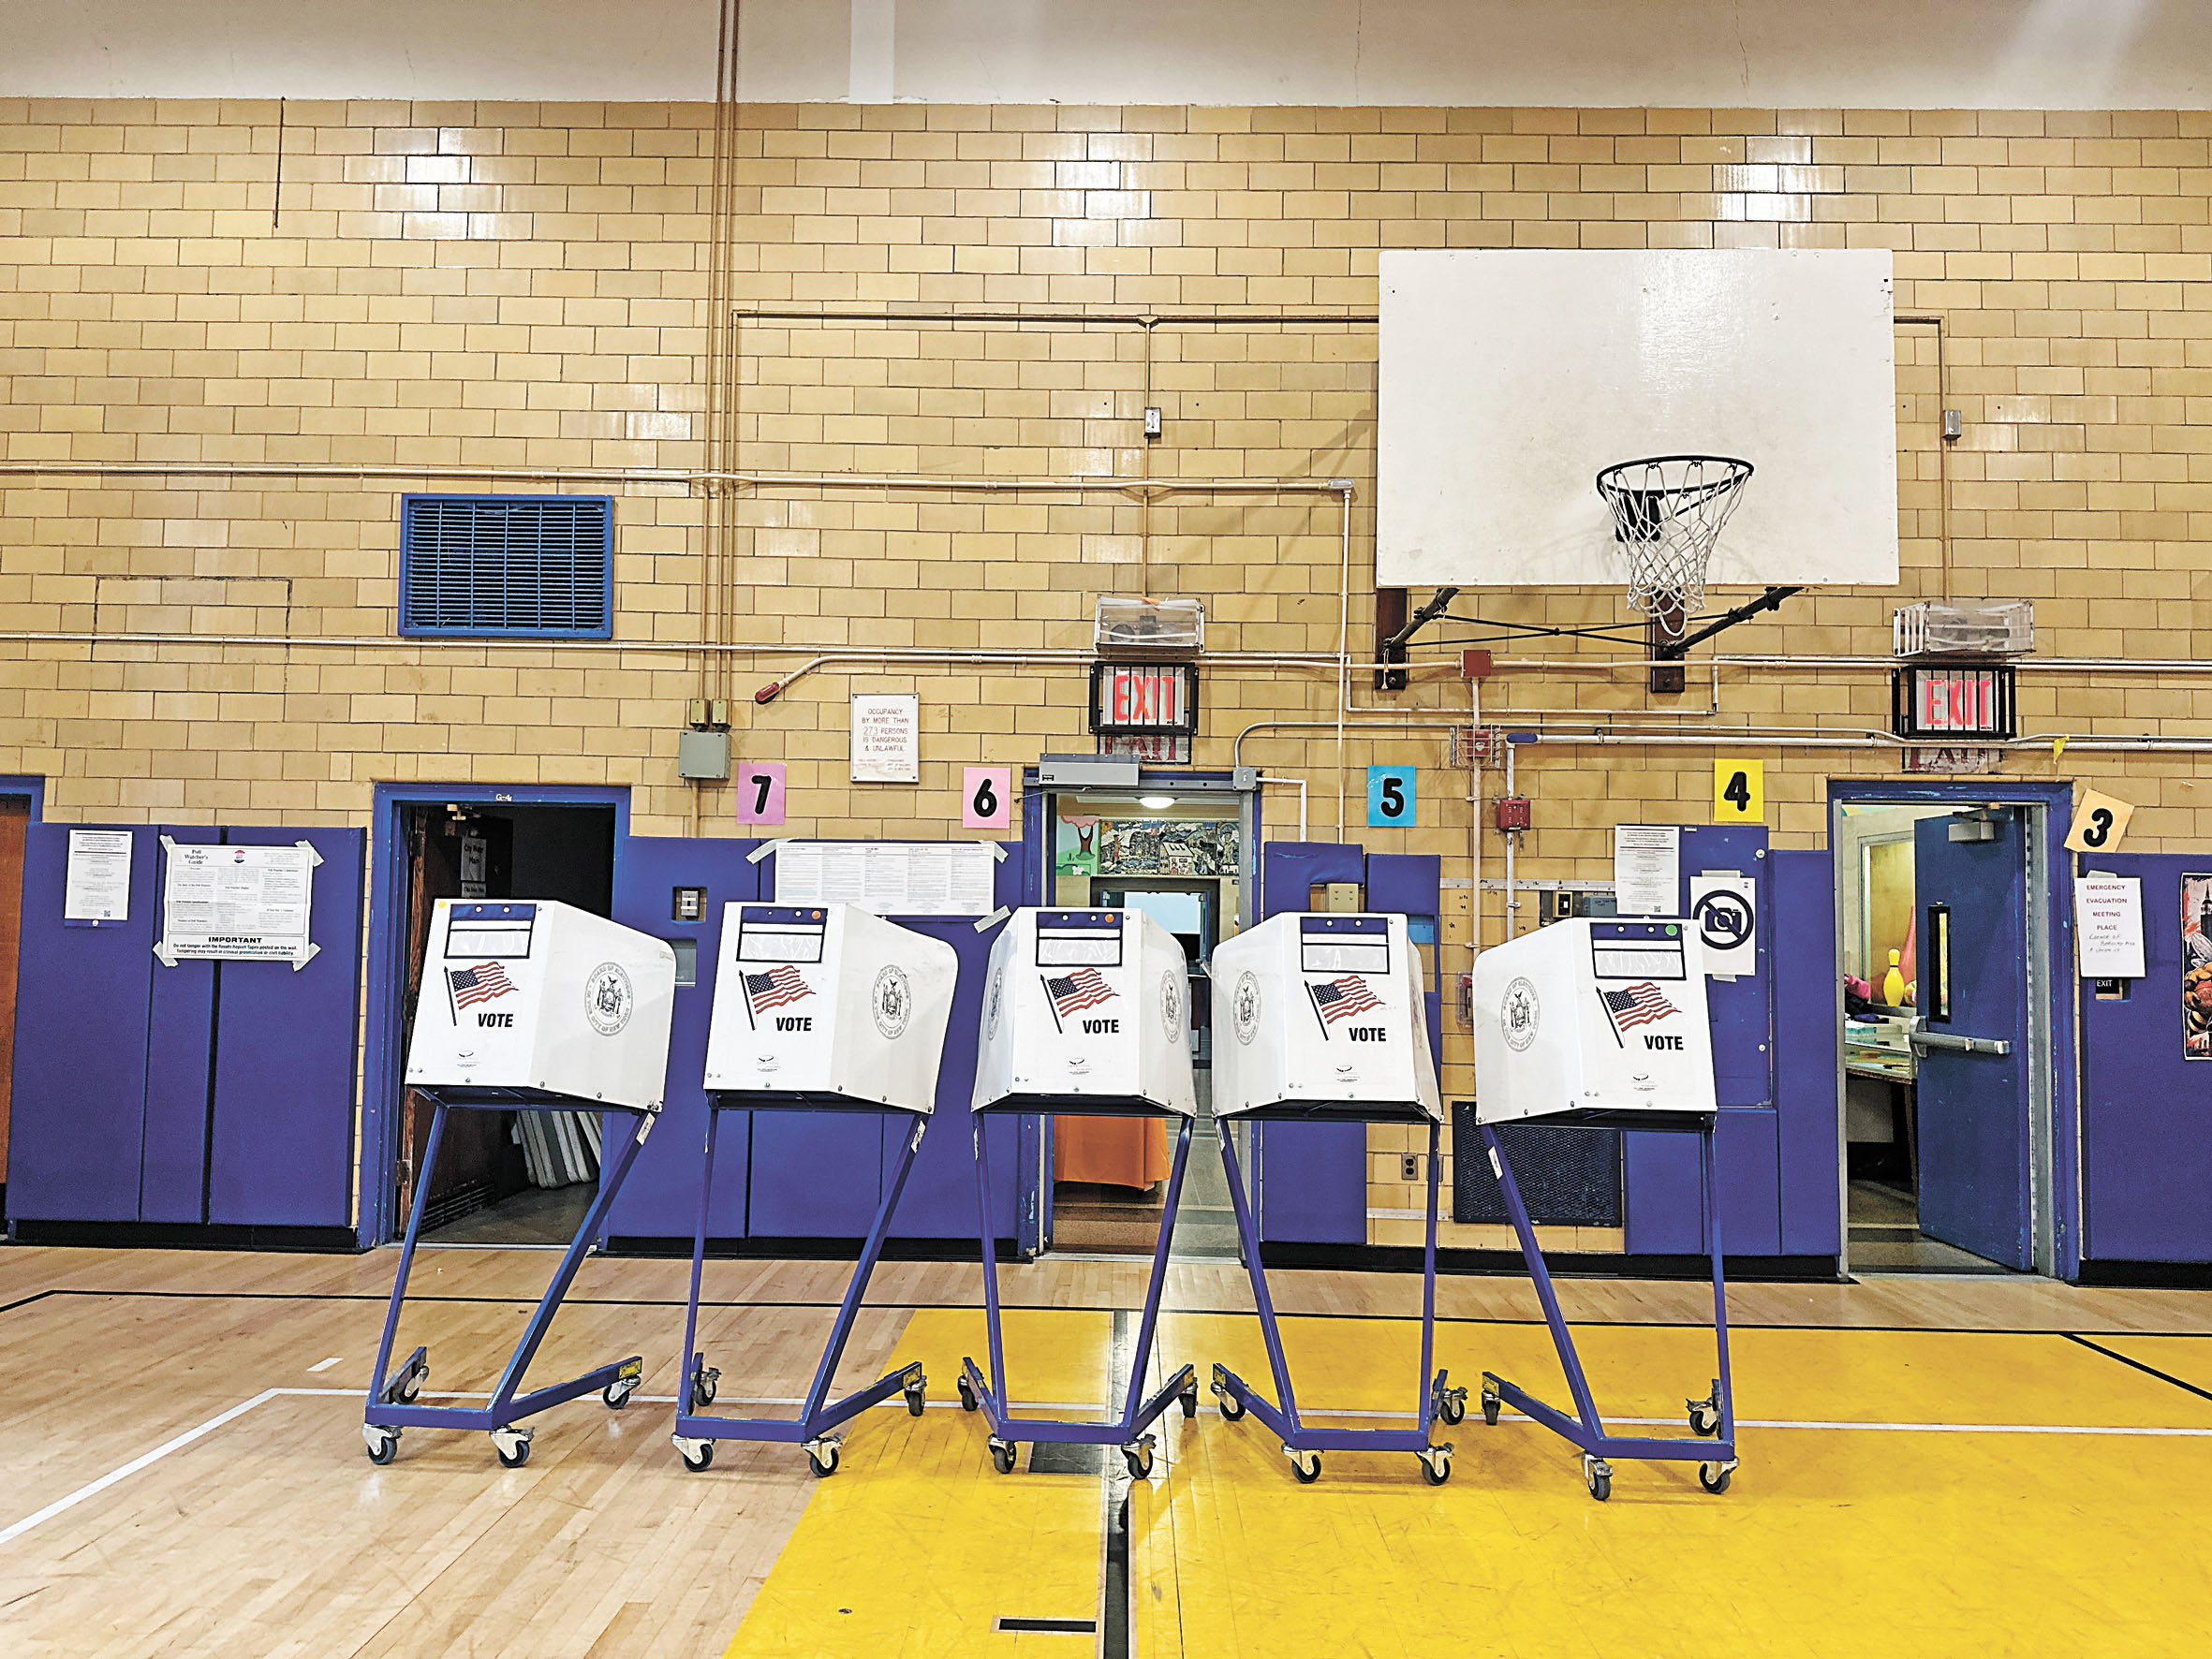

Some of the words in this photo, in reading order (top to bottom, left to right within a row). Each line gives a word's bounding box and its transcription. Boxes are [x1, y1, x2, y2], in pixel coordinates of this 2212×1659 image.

[1114, 675, 1178, 721] EXIT
[1924, 679, 1991, 726] EXIT
[863, 726, 878, 736] 273
[751, 775, 772, 815] 7
[973, 778, 997, 817] 6
[1380, 777, 1405, 817] 5
[1723, 771, 1751, 812] 4
[2083, 808, 2114, 847] 3
[478, 1013, 513, 1028] VOTE
[775, 1017, 812, 1032] VOTE
[1083, 1019, 1119, 1034] VOTE
[1349, 1027, 1386, 1042] VOTE
[1644, 1035, 1684, 1050] VOTE
